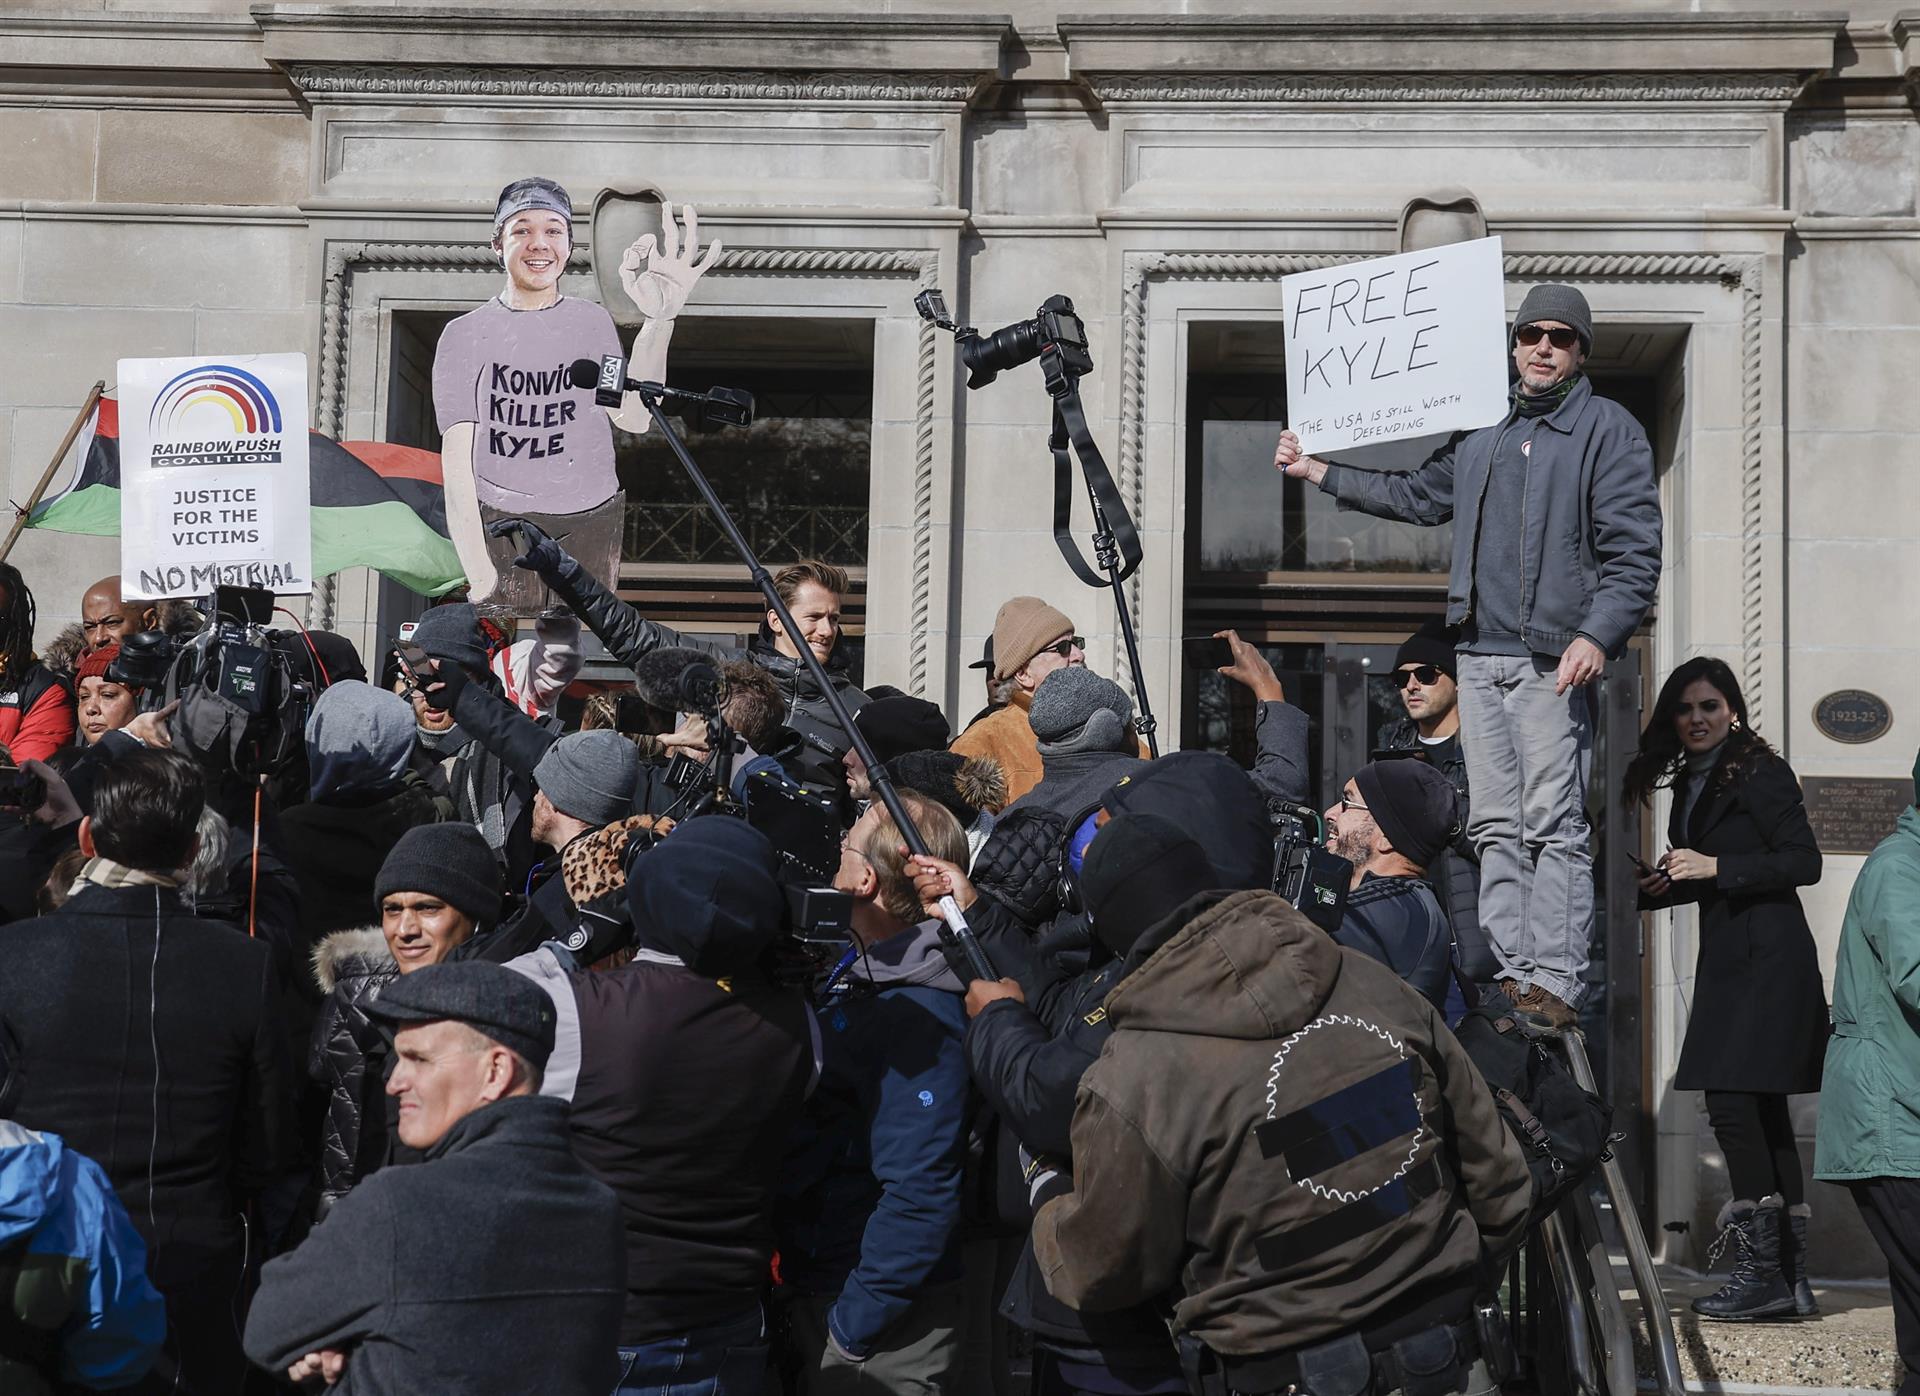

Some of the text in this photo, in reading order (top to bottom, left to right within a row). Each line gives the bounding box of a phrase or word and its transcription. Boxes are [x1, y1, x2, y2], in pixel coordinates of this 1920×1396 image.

[1293, 260, 1440, 339] FREE
[600, 356, 618, 388] WGN
[1303, 325, 1439, 394] KYLE
[1298, 394, 1462, 436] THE USA IS STILL WORTH
[489, 427, 565, 460] KYLE
[1353, 417, 1425, 442] DEFENDING
[157, 454, 274, 466] COALITION
[173, 488, 257, 505] JUSTICE
[173, 508, 258, 526] FOR THE
[172, 529, 259, 546] VICTIMS
[140, 562, 304, 595] NO MISTRIAL
[1831, 710, 1877, 722] 1923-25
